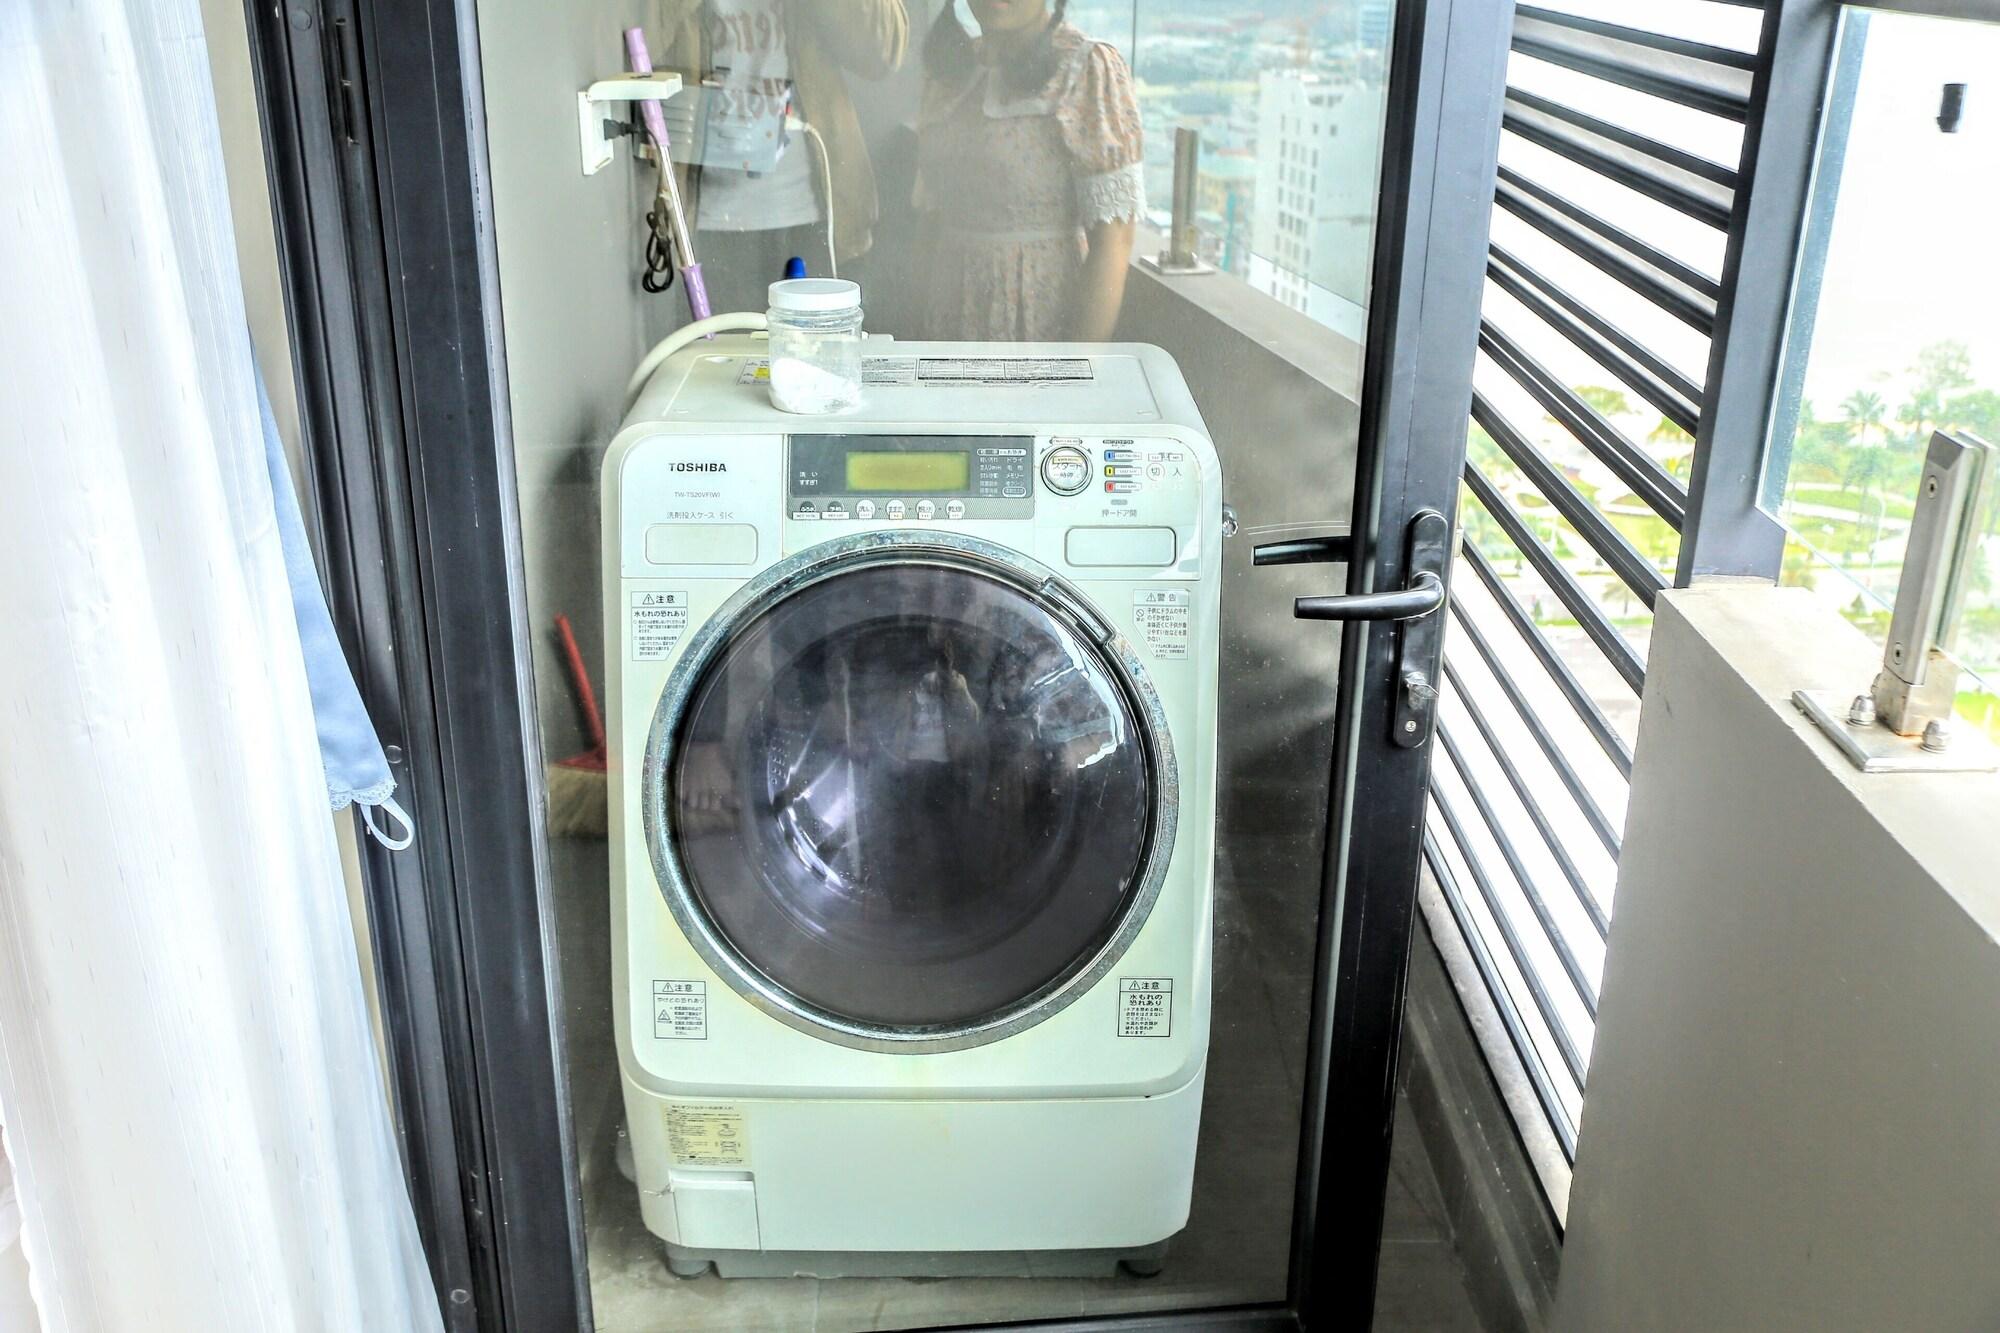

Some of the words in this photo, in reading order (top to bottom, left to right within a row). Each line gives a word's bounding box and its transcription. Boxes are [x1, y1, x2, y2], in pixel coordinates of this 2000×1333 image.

[668, 462, 727, 472] TOSHIBA
[655, 594, 676, 604] 注意
[1157, 593, 1177, 602] 警告
[674, 983, 694, 993] 注意
[1141, 981, 1160, 990] 注意
